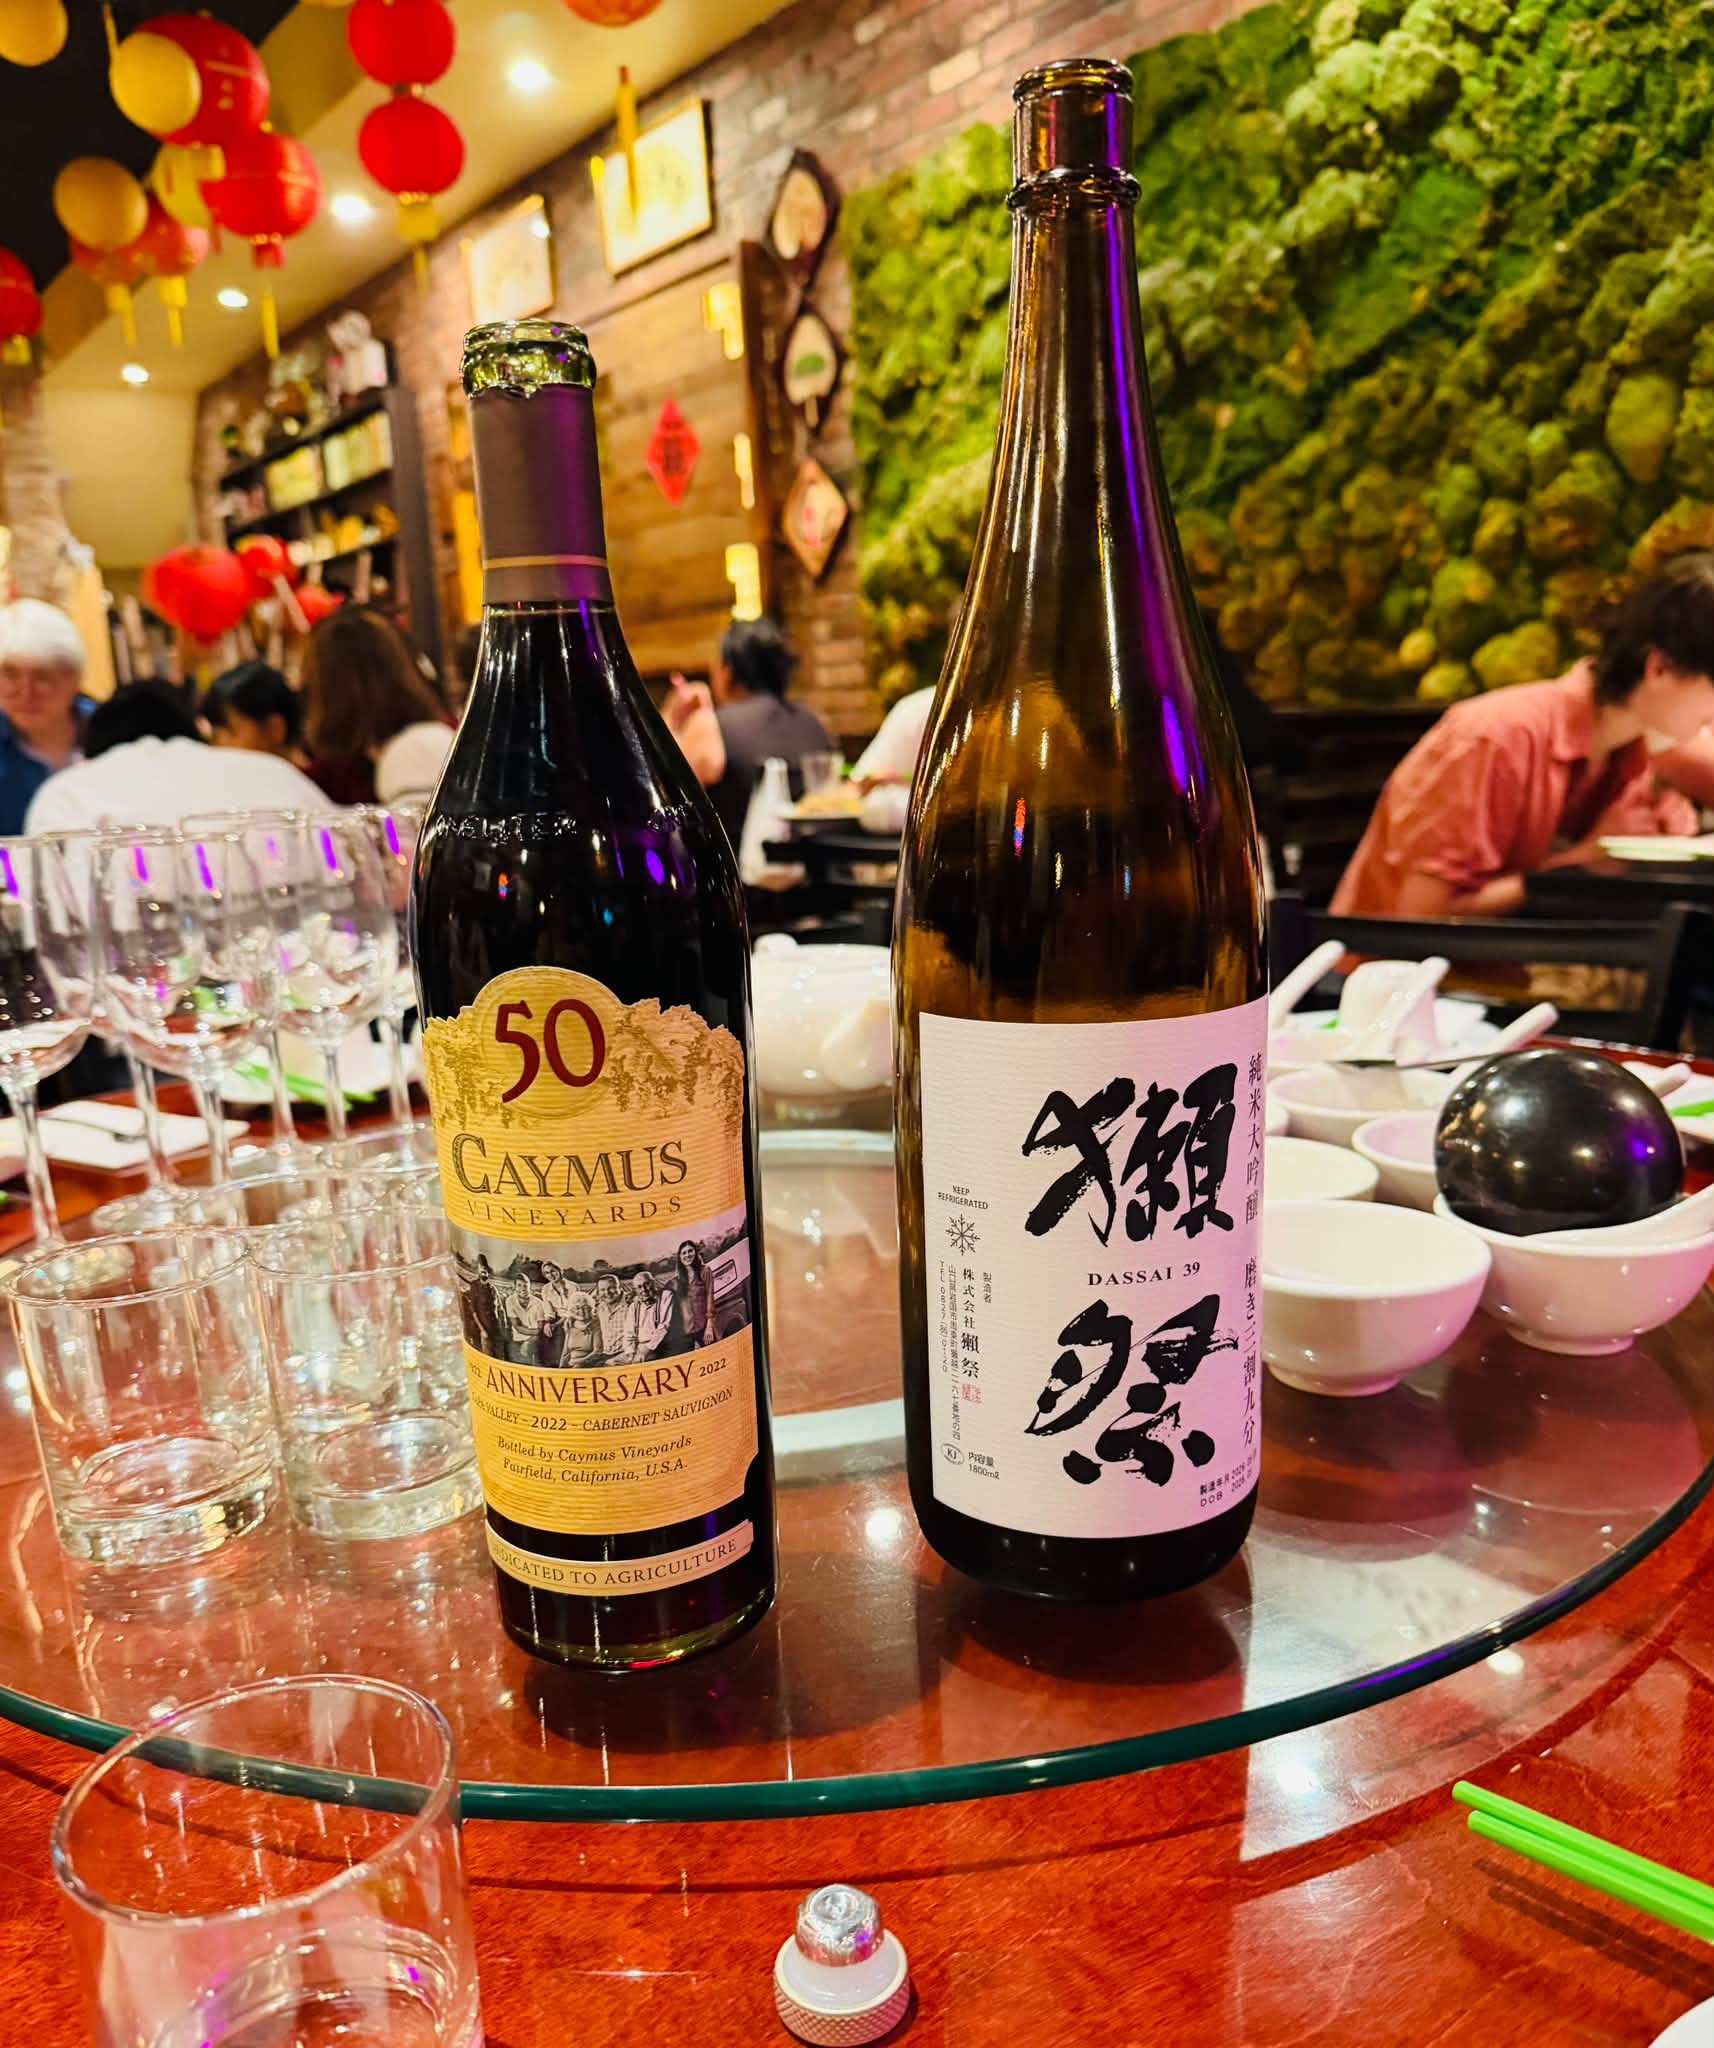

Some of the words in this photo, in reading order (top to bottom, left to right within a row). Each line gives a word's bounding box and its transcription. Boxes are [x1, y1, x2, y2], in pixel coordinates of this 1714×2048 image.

[495, 999, 606, 1103] 50
[451, 1133, 688, 1198] CAYMUS
[938, 1192, 989, 1210] REFRIGERATED
[952, 1185, 970, 1195] KEEP
[467, 1195, 682, 1226] VINEYARDS
[1087, 1265, 1173, 1287] DASSAI
[1183, 1261, 1201, 1278] 39
[486, 1359, 695, 1404] ANNIVERSARY
[699, 1357, 727, 1377] 2022
[486, 1400, 520, 1425] VALLEY
[530, 1415, 568, 1431] 2022
[582, 1411, 660, 1432] CABERNET
[662, 1385, 734, 1422] SAUVIGNON
[497, 1435, 535, 1458] Bottled
[538, 1447, 553, 1462] by
[558, 1449, 616, 1465] Caymus
[621, 1435, 692, 1460] Vineyards
[503, 1457, 557, 1481] Fairfield,
[561, 1468, 640, 1485] California,
[645, 1457, 688, 1477] U.S.A.
[496, 1546, 564, 1581] DICATED
[570, 1571, 597, 1584] TO
[604, 1539, 737, 1584] AGRICULTURE
